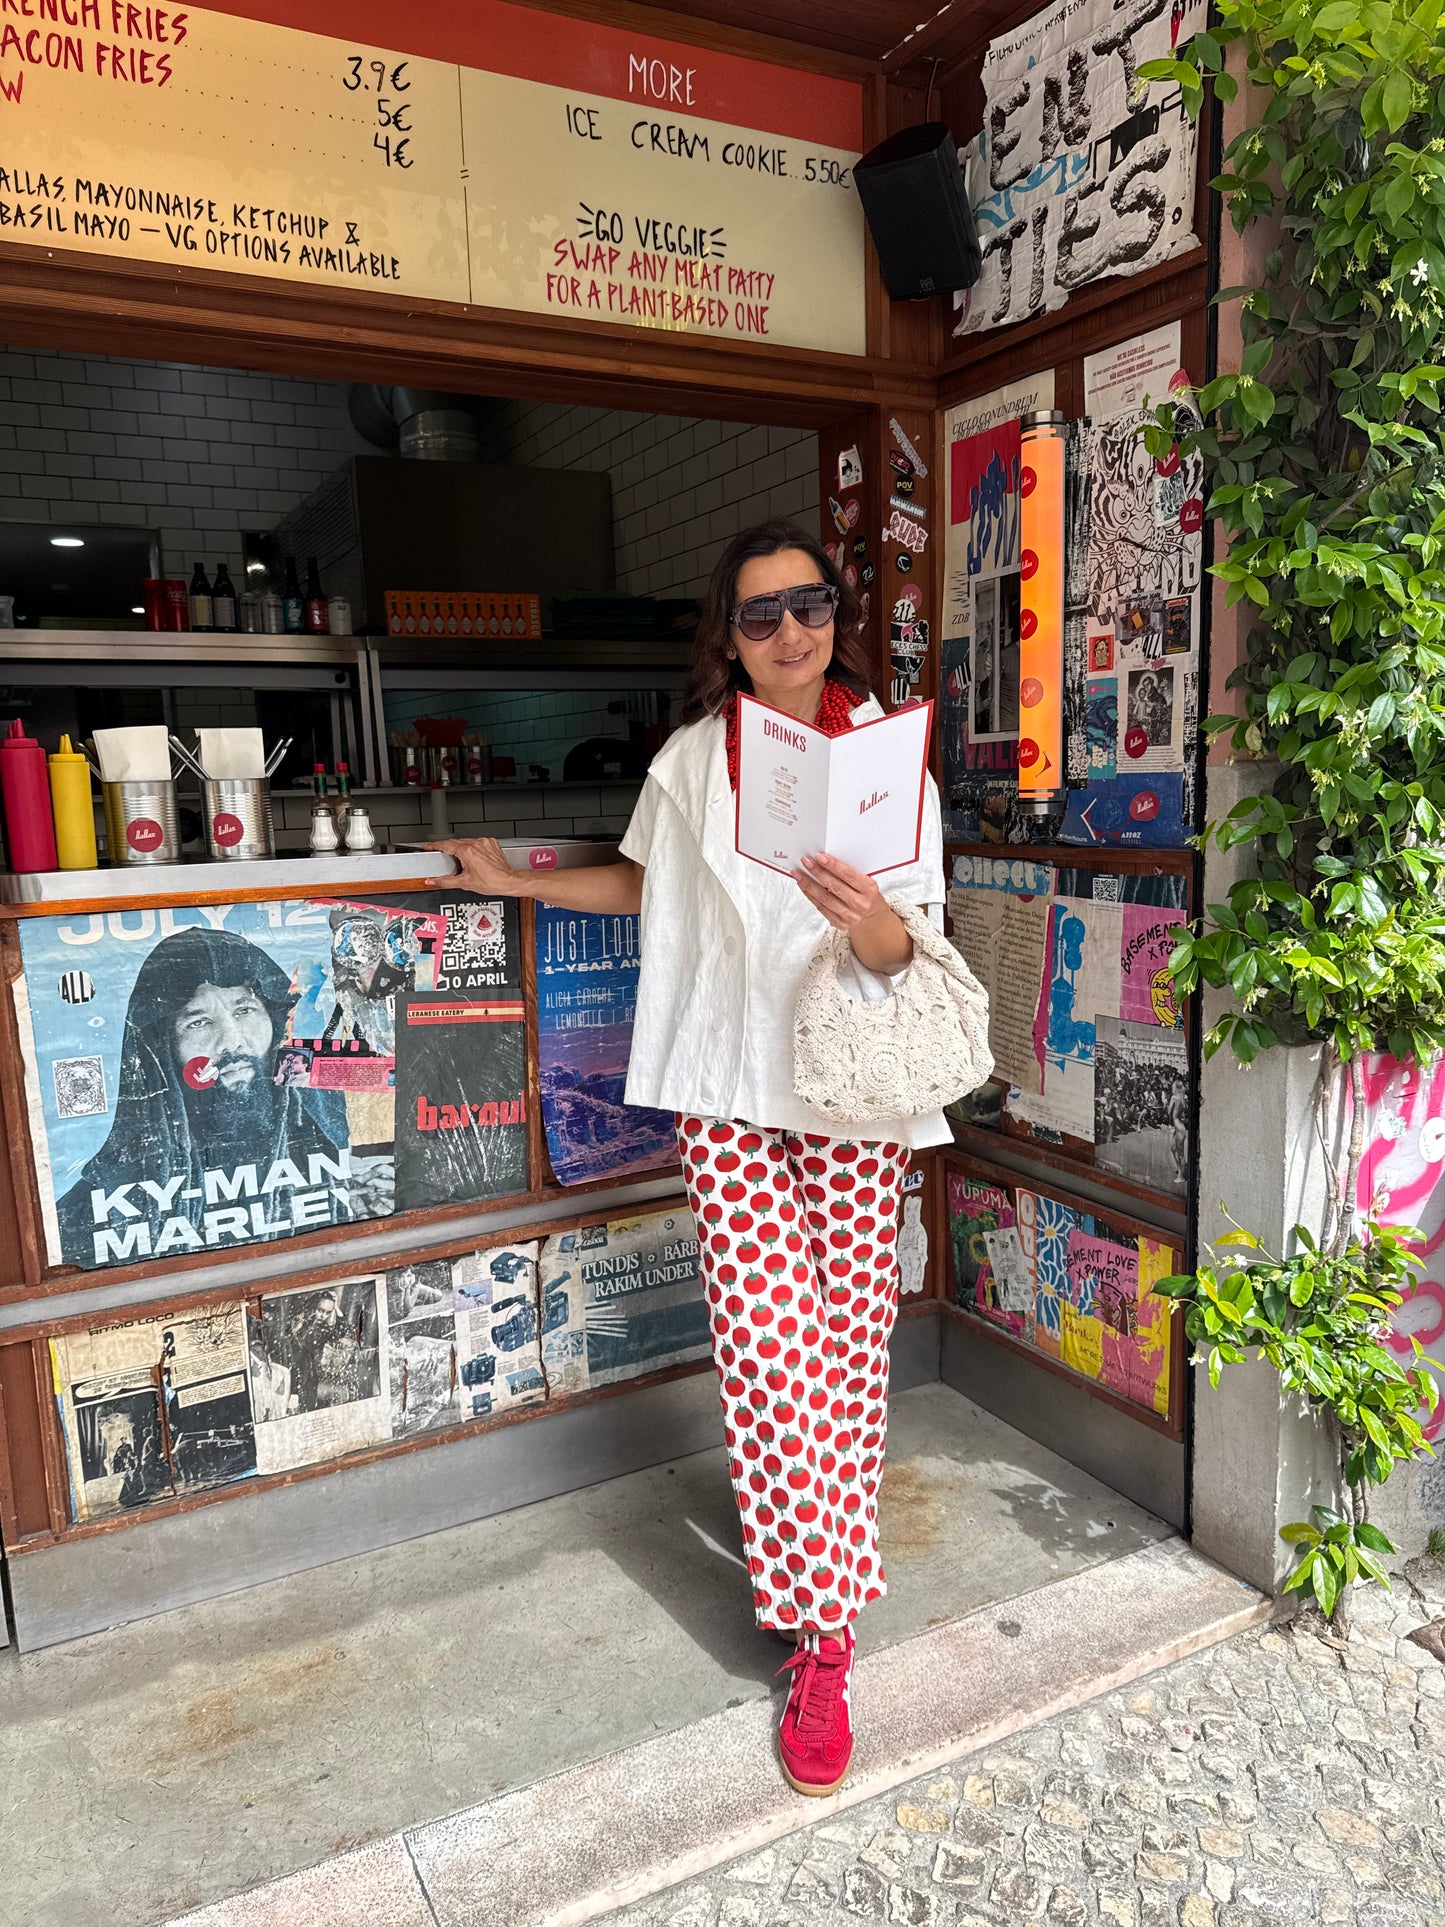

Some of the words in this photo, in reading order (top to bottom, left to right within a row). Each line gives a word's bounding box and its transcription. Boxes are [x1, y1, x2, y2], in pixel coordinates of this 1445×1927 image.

[112, 0, 189, 45] FRIES
[0, 24, 84, 72] ACON
[96, 42, 173, 86] FRIES
[378, 100, 412, 131] 5€
[628, 53, 698, 106] MORE
[373, 133, 414, 168] 4€
[566, 104, 602, 140] ICE
[631, 121, 710, 162] CREAM
[722, 142, 788, 177] COOKIE
[75, 178, 225, 228] MAYONNAISE,
[233, 203, 329, 240] KETCHUP
[0, 203, 67, 233] BASIL
[74, 210, 131, 241] MAYO
[165, 223, 197, 251] VG
[205, 229, 292, 265] OPTIONS
[299, 245, 401, 281] AVAILABLE
[595, 210, 624, 245] GO
[635, 217, 710, 259] VEGGIE
[554, 239, 621, 275] SWAP
[628, 251, 668, 284] ANY
[675, 259, 723, 289] MEAT
[728, 268, 775, 300] PATTY
[547, 274, 581, 308] FOR
[587, 284, 602, 306] A
[608, 283, 729, 330] PLANT-BASED
[735, 305, 769, 334] ONE
[897, 481, 913, 489] POV
[890, 512, 927, 550] RUDE
[951, 612, 970, 625] ZDB
[909, 643, 928, 651] CHESS
[764, 719, 807, 753] DRINKS
[57, 905, 232, 945] JULY
[256, 898, 327, 928] 12
[544, 919, 587, 963] JUST
[602, 915, 641, 959] LOO
[466, 972, 508, 988] APRIL
[544, 960, 613, 975] 1-YEAR
[408, 1010, 440, 1018] LEBANESE
[441, 1009, 464, 1017] EATERY
[90, 1148, 352, 1224] KY-MAN
[582, 1252, 639, 1280] TUNDJS
[594, 1273, 643, 1298] RAKIM
[645, 1261, 695, 1286] UNDER
[1107, 1252, 1137, 1271] LOVE
[88, 1322, 134, 1337] RITMO
[138, 1312, 175, 1326] LOCO
